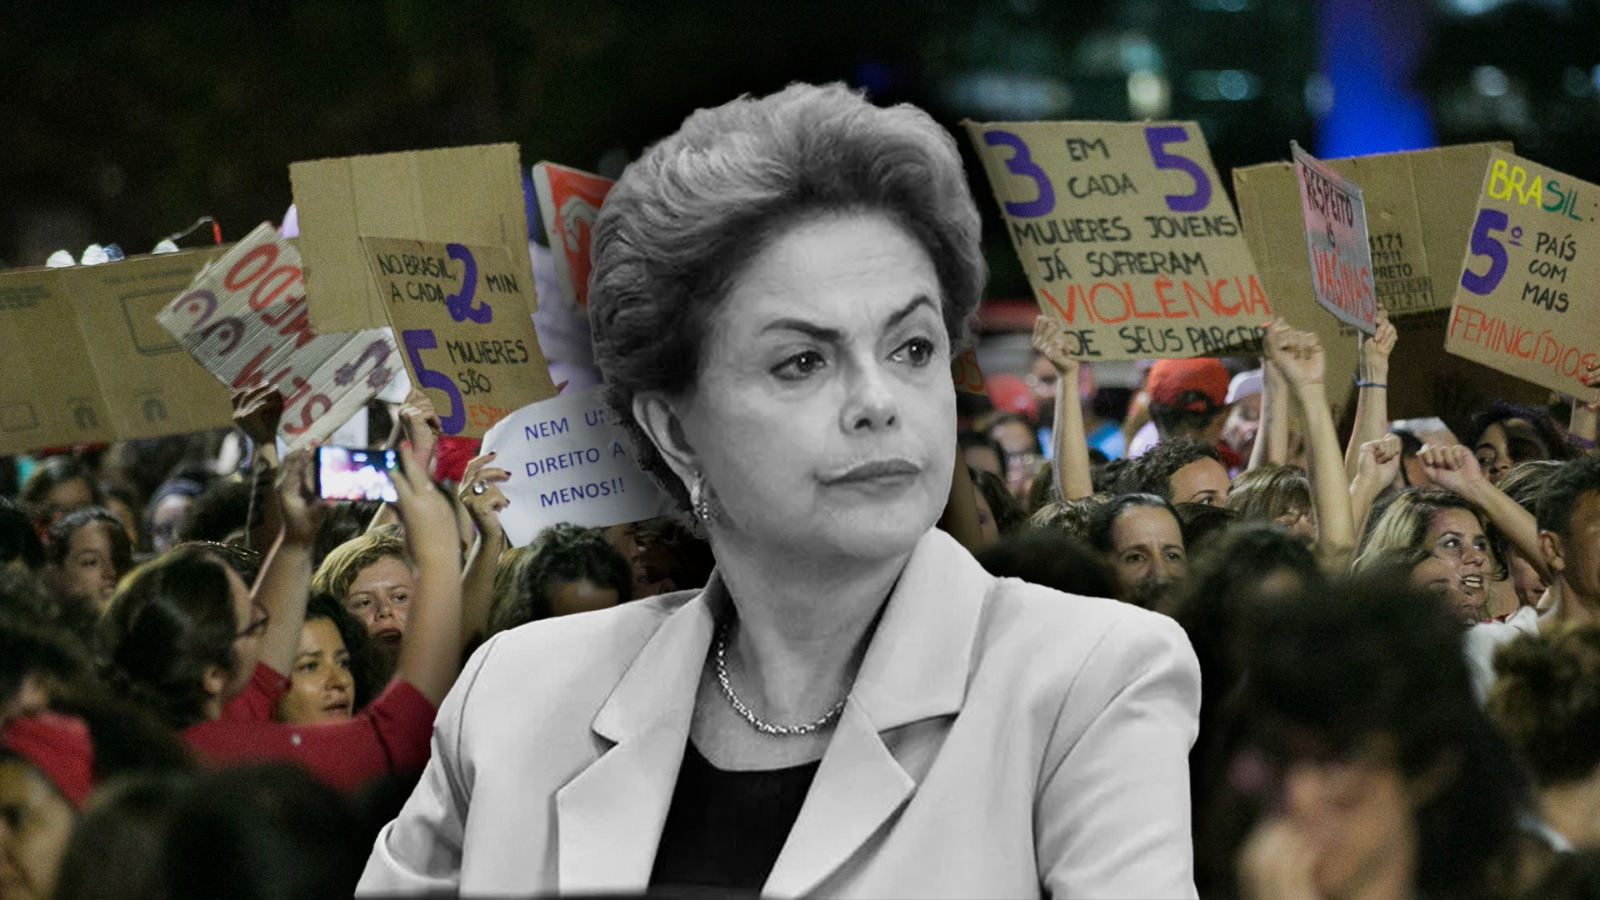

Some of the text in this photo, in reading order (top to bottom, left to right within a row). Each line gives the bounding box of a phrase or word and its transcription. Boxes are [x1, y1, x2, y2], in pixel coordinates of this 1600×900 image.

[984, 126, 1213, 218] 3 EM 5
[1068, 173, 1138, 199] CADA
[1012, 214, 1239, 247] MULHERES JOVENS
[1535, 231, 1577, 262] PAÍS
[376, 254, 403, 276] NO
[1037, 249, 1210, 283] JÁ SOFRERAM
[1373, 263, 1413, 278] PRETO
[1528, 259, 1567, 284] COM
[390, 243, 520, 324] A CADA 2 MIN
[1041, 273, 1272, 325] VIOLÊNCIA
[1522, 281, 1569, 313] MAIS
[1119, 326, 1184, 354] SEUS
[402, 329, 529, 435] 5 MULHERES
[458, 369, 492, 396] SÃO
[524, 417, 570, 441] NEM
[525, 448, 600, 478] DIREITO
[540, 477, 626, 509] MENOS!!
